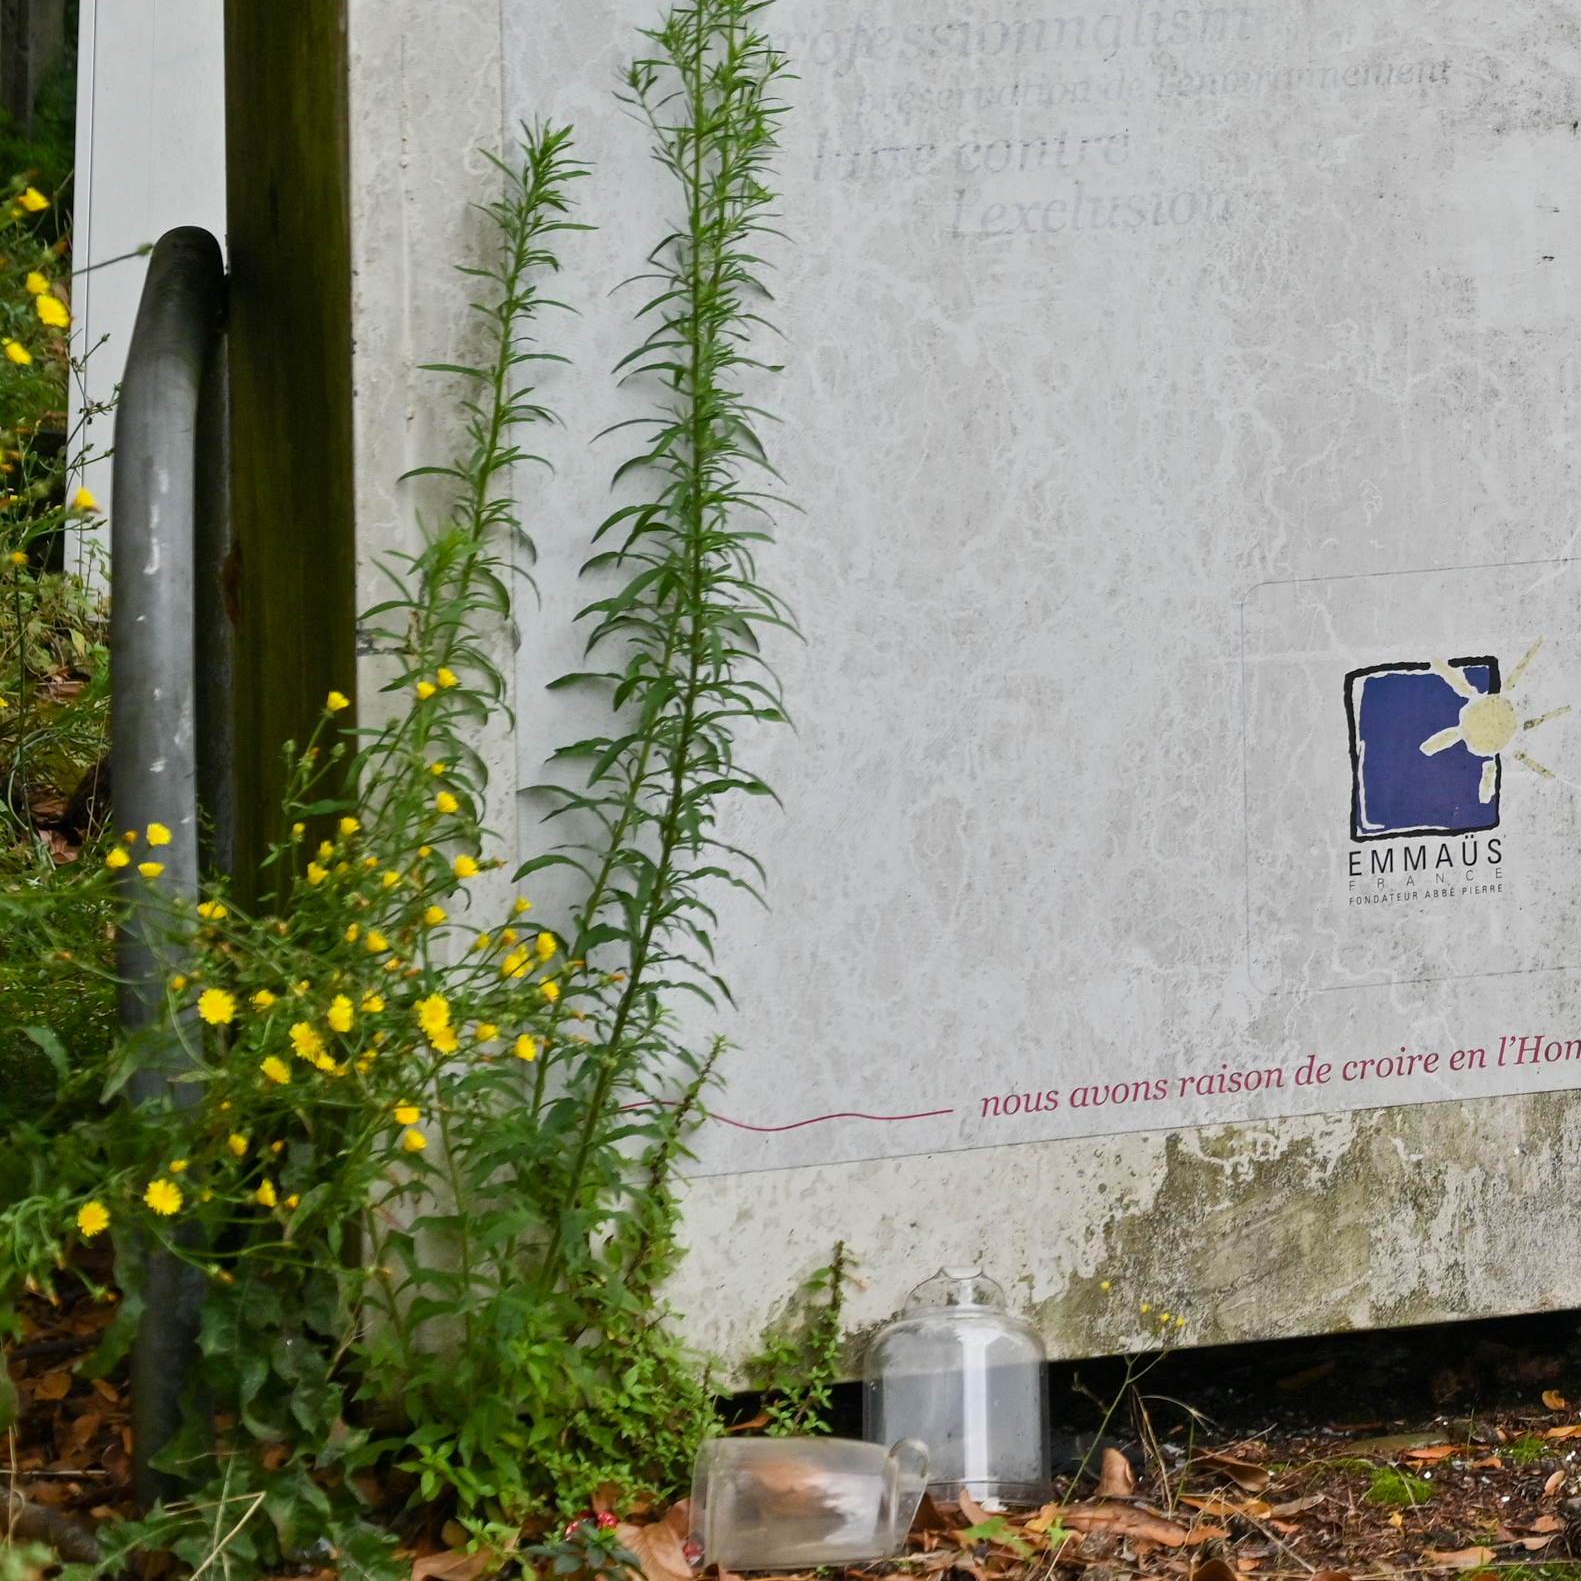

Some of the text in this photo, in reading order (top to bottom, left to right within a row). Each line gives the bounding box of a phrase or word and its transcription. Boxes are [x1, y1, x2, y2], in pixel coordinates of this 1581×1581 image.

[1348, 834, 1503, 877] EMMAÜS
[1349, 866, 1503, 892] FRANCE
[1349, 883, 1503, 906] FONDATEUR ABBÉ PIERRE
[980, 1088, 1059, 1118] nous
[1068, 1078, 1168, 1109] avons
[1178, 1063, 1285, 1098] raison
[1294, 1054, 1333, 1086] de
[1342, 1045, 1440, 1082] croire
[1448, 1047, 1488, 1072] en
